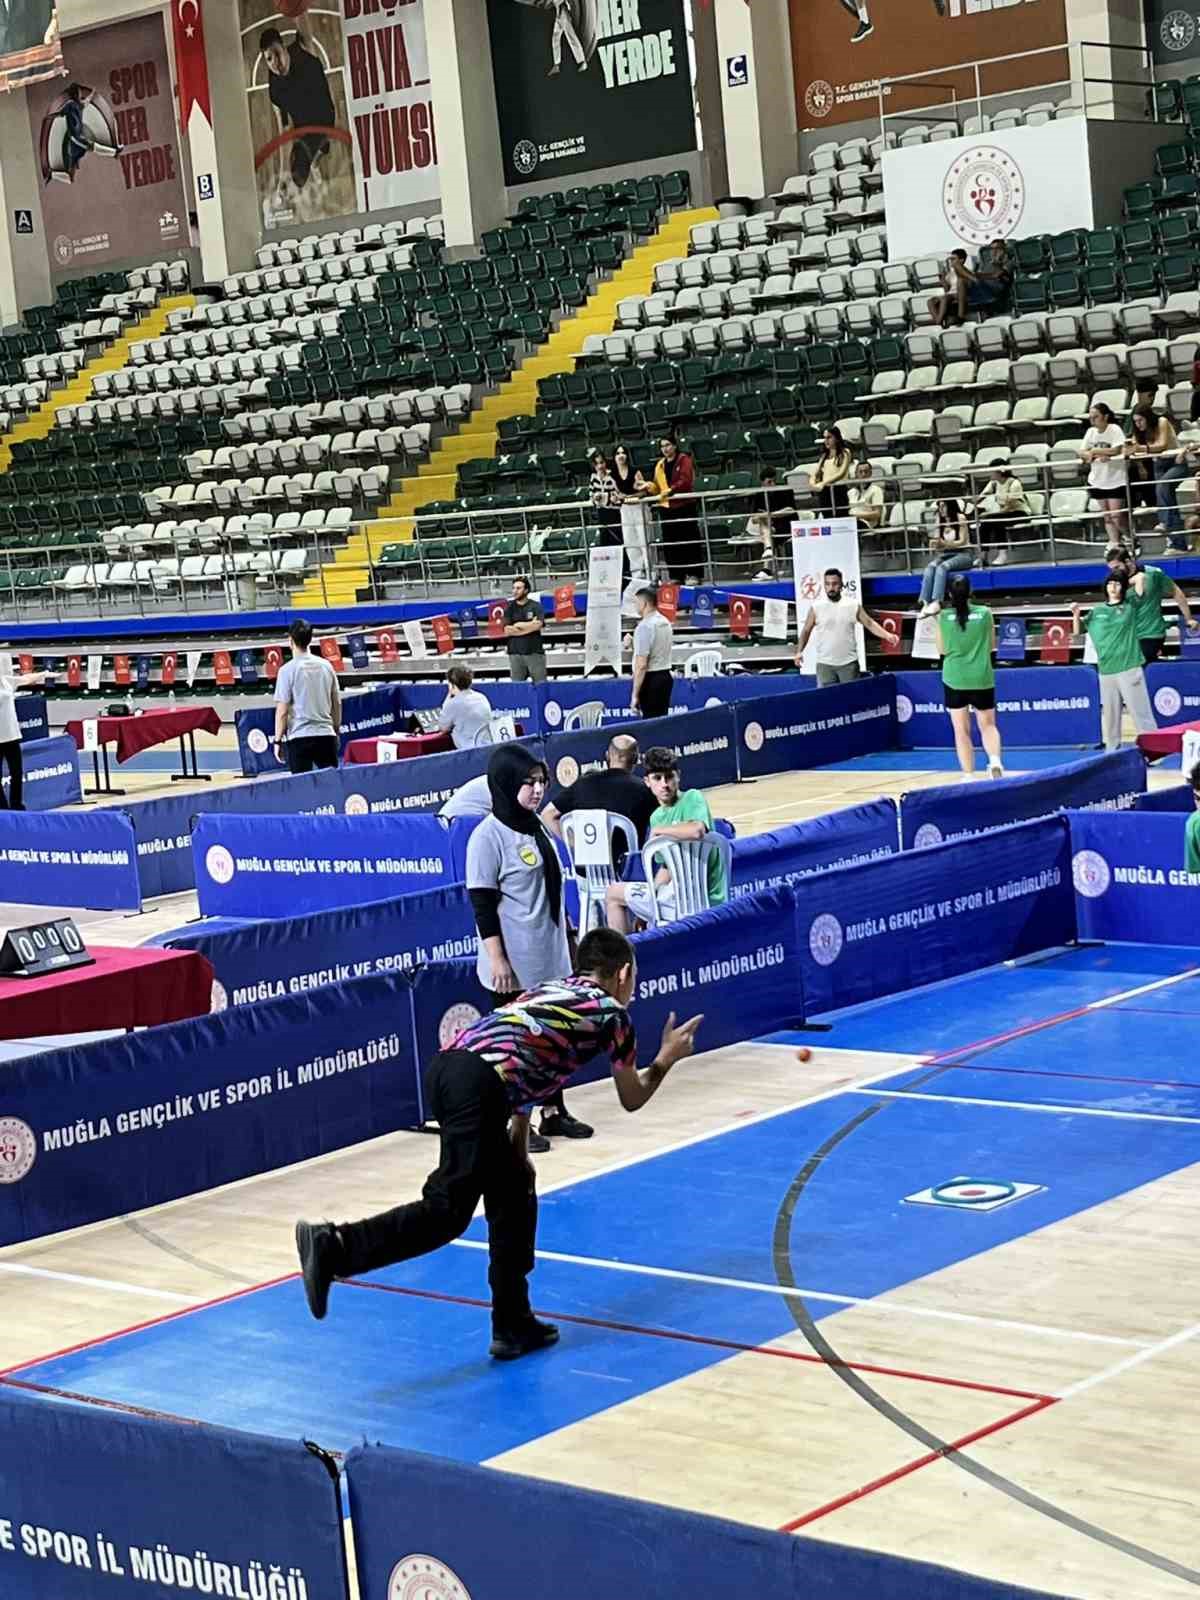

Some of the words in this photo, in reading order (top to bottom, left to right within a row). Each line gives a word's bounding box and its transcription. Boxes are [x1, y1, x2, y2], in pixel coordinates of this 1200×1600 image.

[597, 30, 676, 89] YERDE
[730, 56, 744, 78] C
[109, 61, 159, 105] SPOR
[354, 103, 431, 178] YÜKS
[120, 143, 176, 190] YERDE
[201, 175, 210, 192] B
[19, 211, 31, 226] A
[997, 701, 1021, 712] SPOR
[371, 798, 401, 813] MUĞLA
[403, 790, 439, 808] GENÇLİK
[583, 823, 597, 845] 9
[51, 852, 71, 864] SPOR
[138, 838, 175, 855] MUĞLA
[236, 857, 272, 873] MUĞLA
[274, 857, 317, 876] GENÇLİK
[318, 860, 332, 873] VE
[334, 860, 362, 874] SPOR
[364, 857, 375, 874] İL
[376, 858, 443, 874] MÜDÜRLÜĞÜ
[1114, 865, 1166, 885] MUĞLA
[1169, 870, 1200, 886] GEN
[846, 917, 886, 943] MUĞLA
[889, 905, 936, 932] GENÇLİK
[938, 902, 953, 918] VE
[954, 893, 983, 912] SPOR
[985, 887, 996, 905] İL
[997, 868, 1061, 901] MÜDÜRLÜĞÜ
[233, 980, 285, 1006] MUĞLA
[353, 960, 371, 977] VE
[376, 953, 412, 973] SPOR
[432, 935, 481, 961] MÜDÜR
[639, 974, 678, 999] SPOR
[682, 967, 695, 989] İL
[698, 943, 785, 985] MÜDÜRLÜĞÜ
[43, 1118, 112, 1151] MUĞLA
[116, 1095, 194, 1135] GENÇLİK
[198, 1088, 222, 1112] VE
[226, 1073, 272, 1106] SPOR
[277, 1066, 293, 1091] İL
[298, 1032, 400, 1085] MÜDÜRLÜĞÜ
[20, 1523, 92, 1568] SPOR
[96, 1532, 124, 1575] İL
[128, 1543, 308, 1600] MÜDÜRLÜĞÜ
